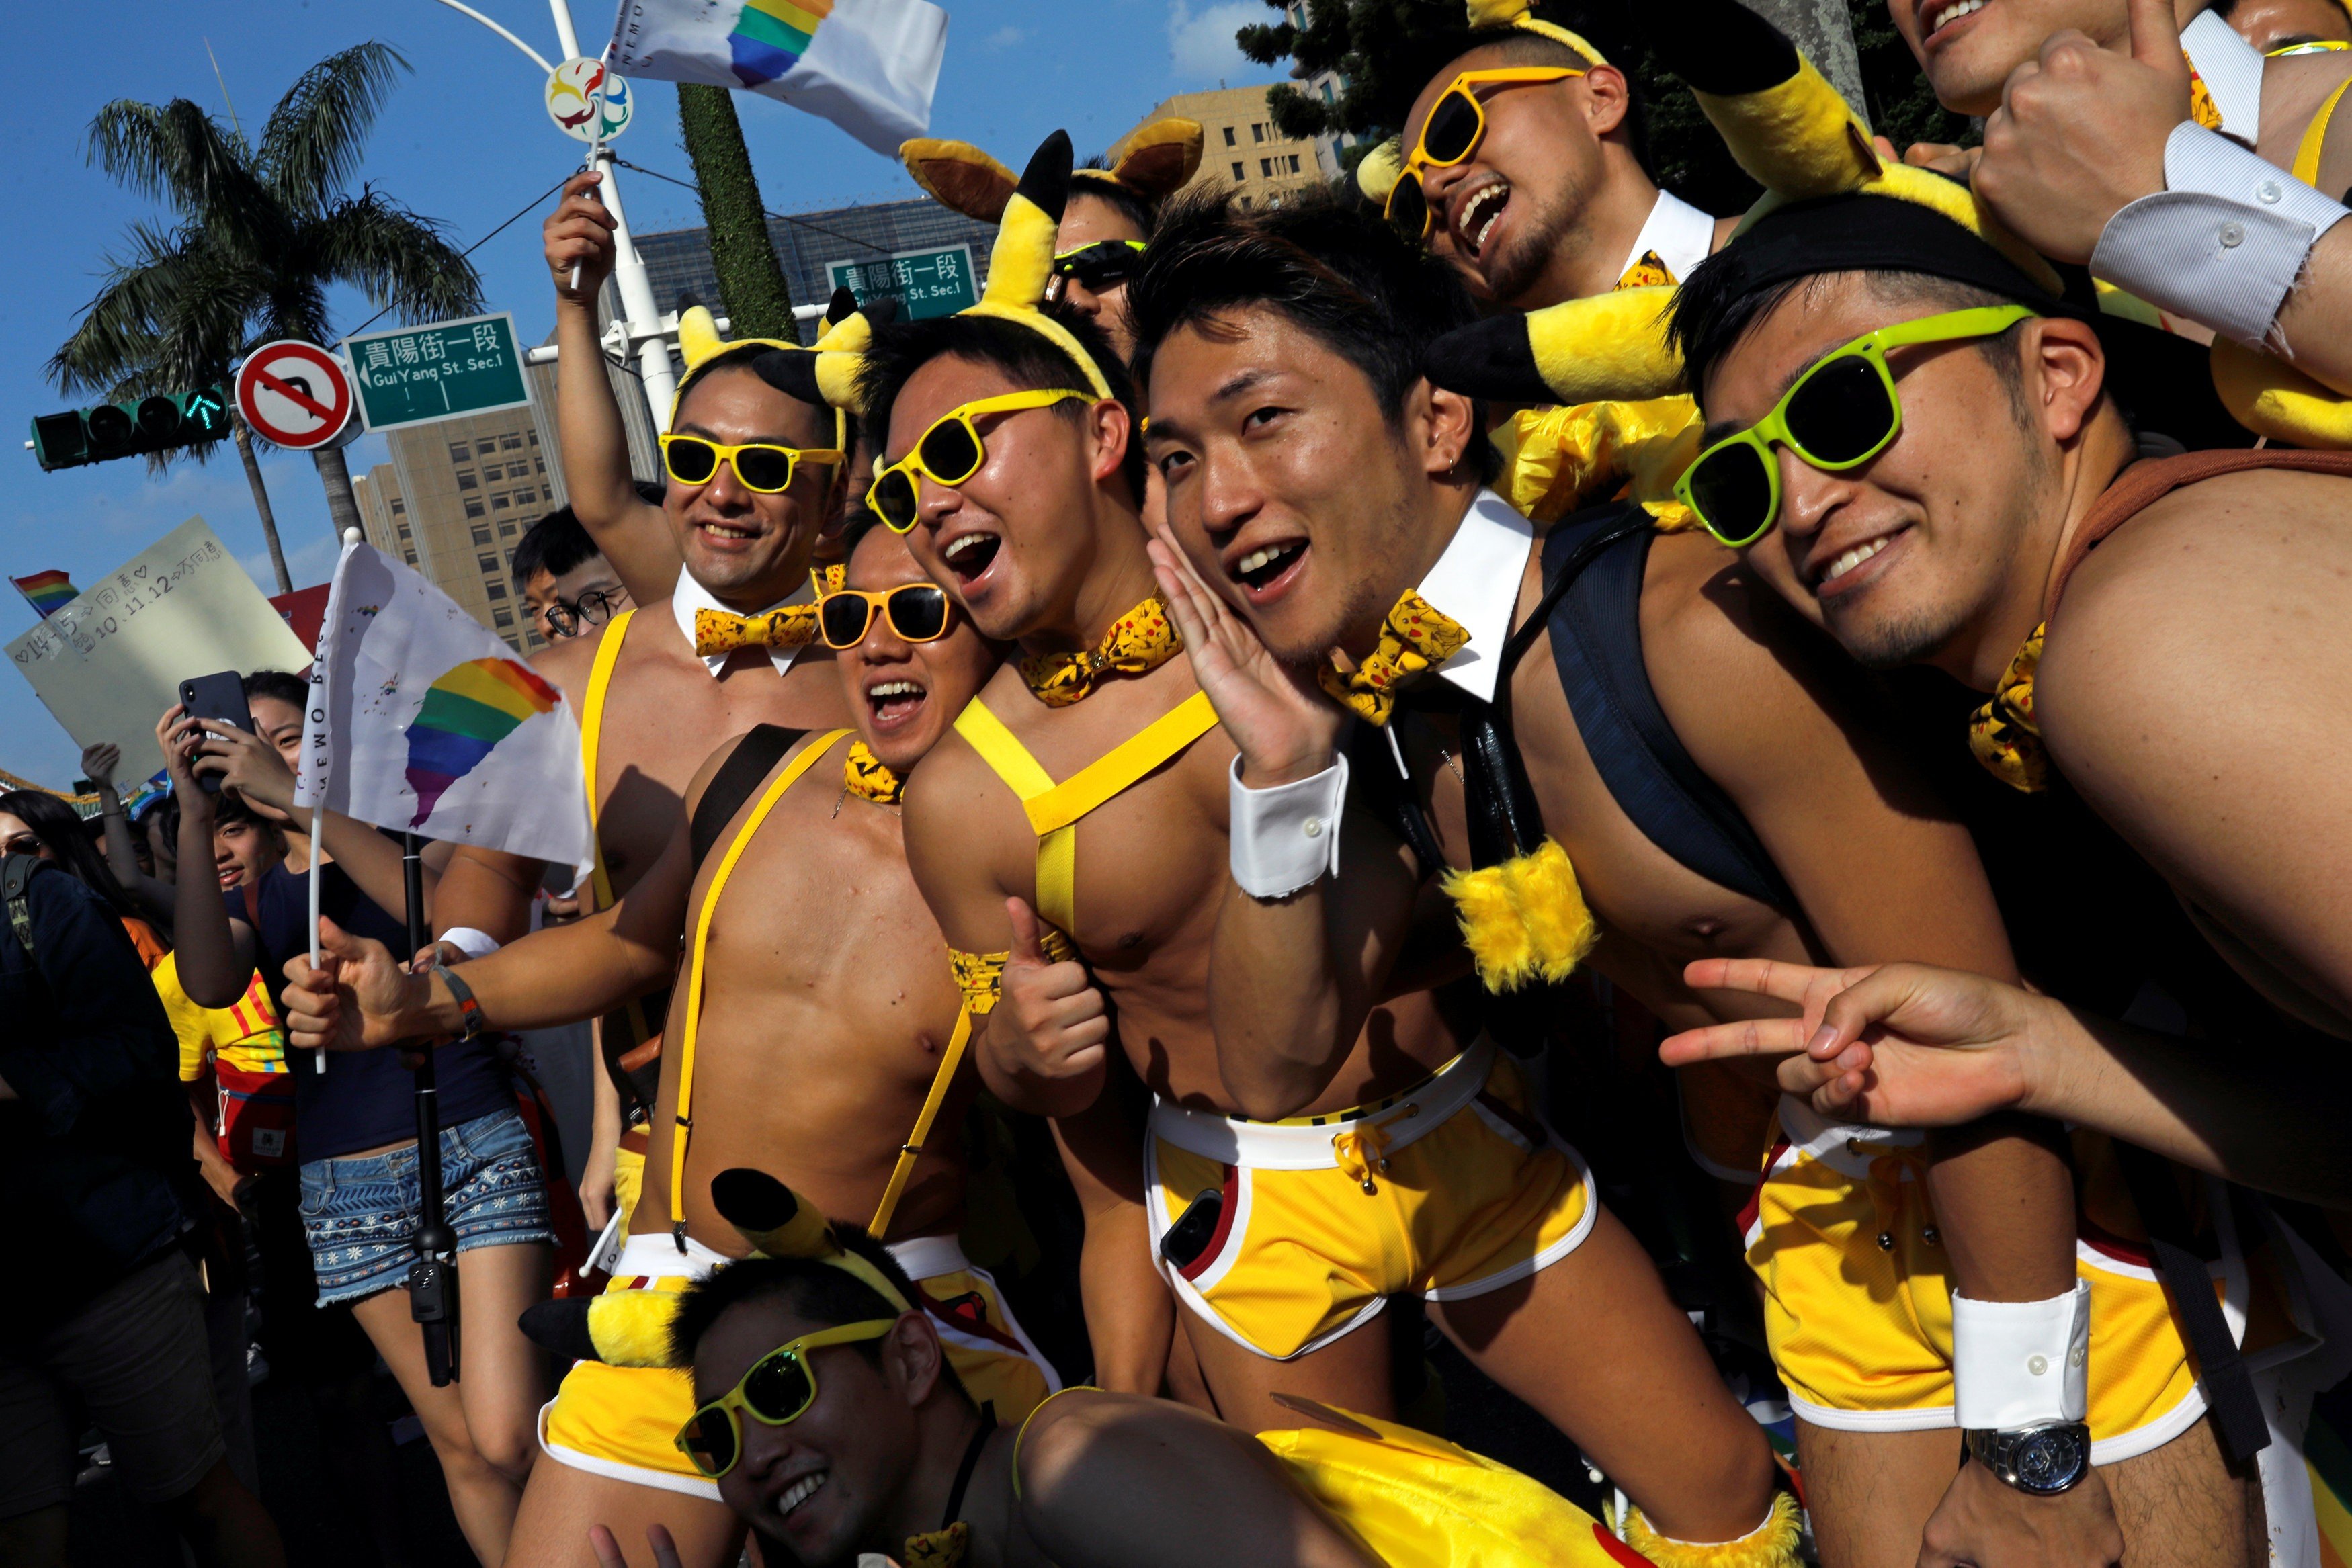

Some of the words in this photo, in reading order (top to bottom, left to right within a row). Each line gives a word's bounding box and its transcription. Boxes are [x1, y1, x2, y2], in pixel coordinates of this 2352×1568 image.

[845, 254, 959, 292] 貴陽街一段
[910, 288, 927, 300] St.
[931, 282, 960, 296] Sec.1
[365, 324, 500, 370] 貴陽街一段
[374, 369, 438, 387] GuiYang
[442, 363, 463, 376] St.
[467, 353, 503, 371] Sec.1
[177, 540, 222, 575] 不同意
[96, 573, 140, 609] 同意
